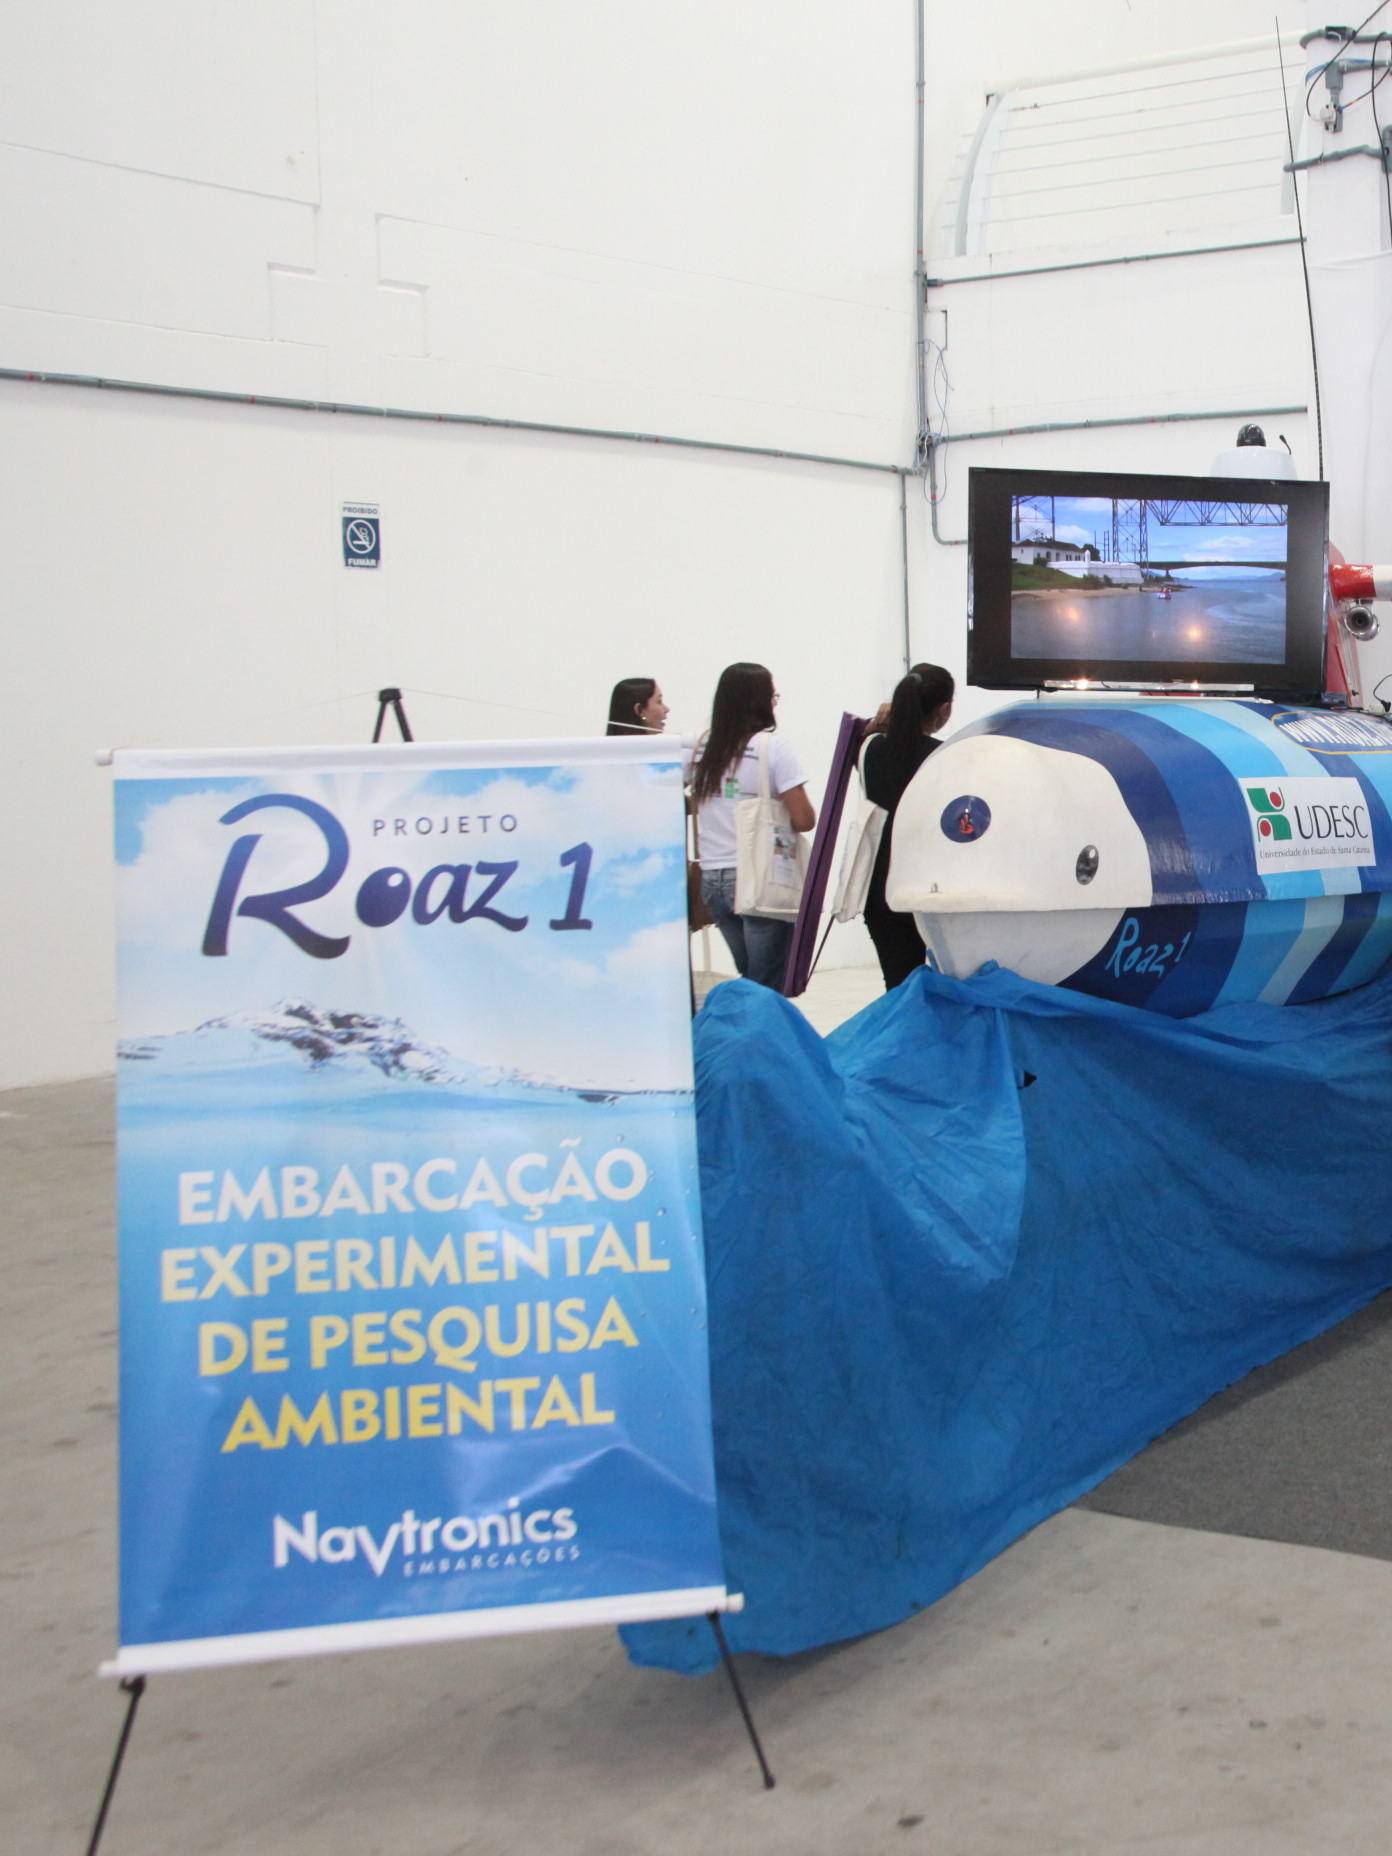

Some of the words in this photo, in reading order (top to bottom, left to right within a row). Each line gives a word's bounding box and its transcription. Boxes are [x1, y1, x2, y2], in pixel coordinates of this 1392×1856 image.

[342, 506, 378, 514] PROIBIDO
[347, 558, 377, 566] FUMAR
[373, 814, 519, 837] PROJETO
[1260, 847, 1301, 859] Universidade
[1302, 848, 1310, 856] do
[1311, 846, 1330, 855] Estado
[1330, 846, 1337, 854] de
[1337, 845, 1352, 854] Santa
[1294, 805, 1369, 840] UDESC
[201, 793, 529, 959] Roaz
[549, 841, 594, 931] 1
[1104, 917, 1174, 978] Roaz
[1174, 931, 1191, 962] 1
[178, 1137, 648, 1226] EMBARCAÇÃO
[160, 1221, 671, 1302] EXPERIMENTAL
[198, 1317, 290, 1378] DE
[309, 1296, 640, 1374] PESQUISA
[220, 1372, 616, 1454] AMBIENTAL
[273, 1496, 578, 1577] Navtronics
